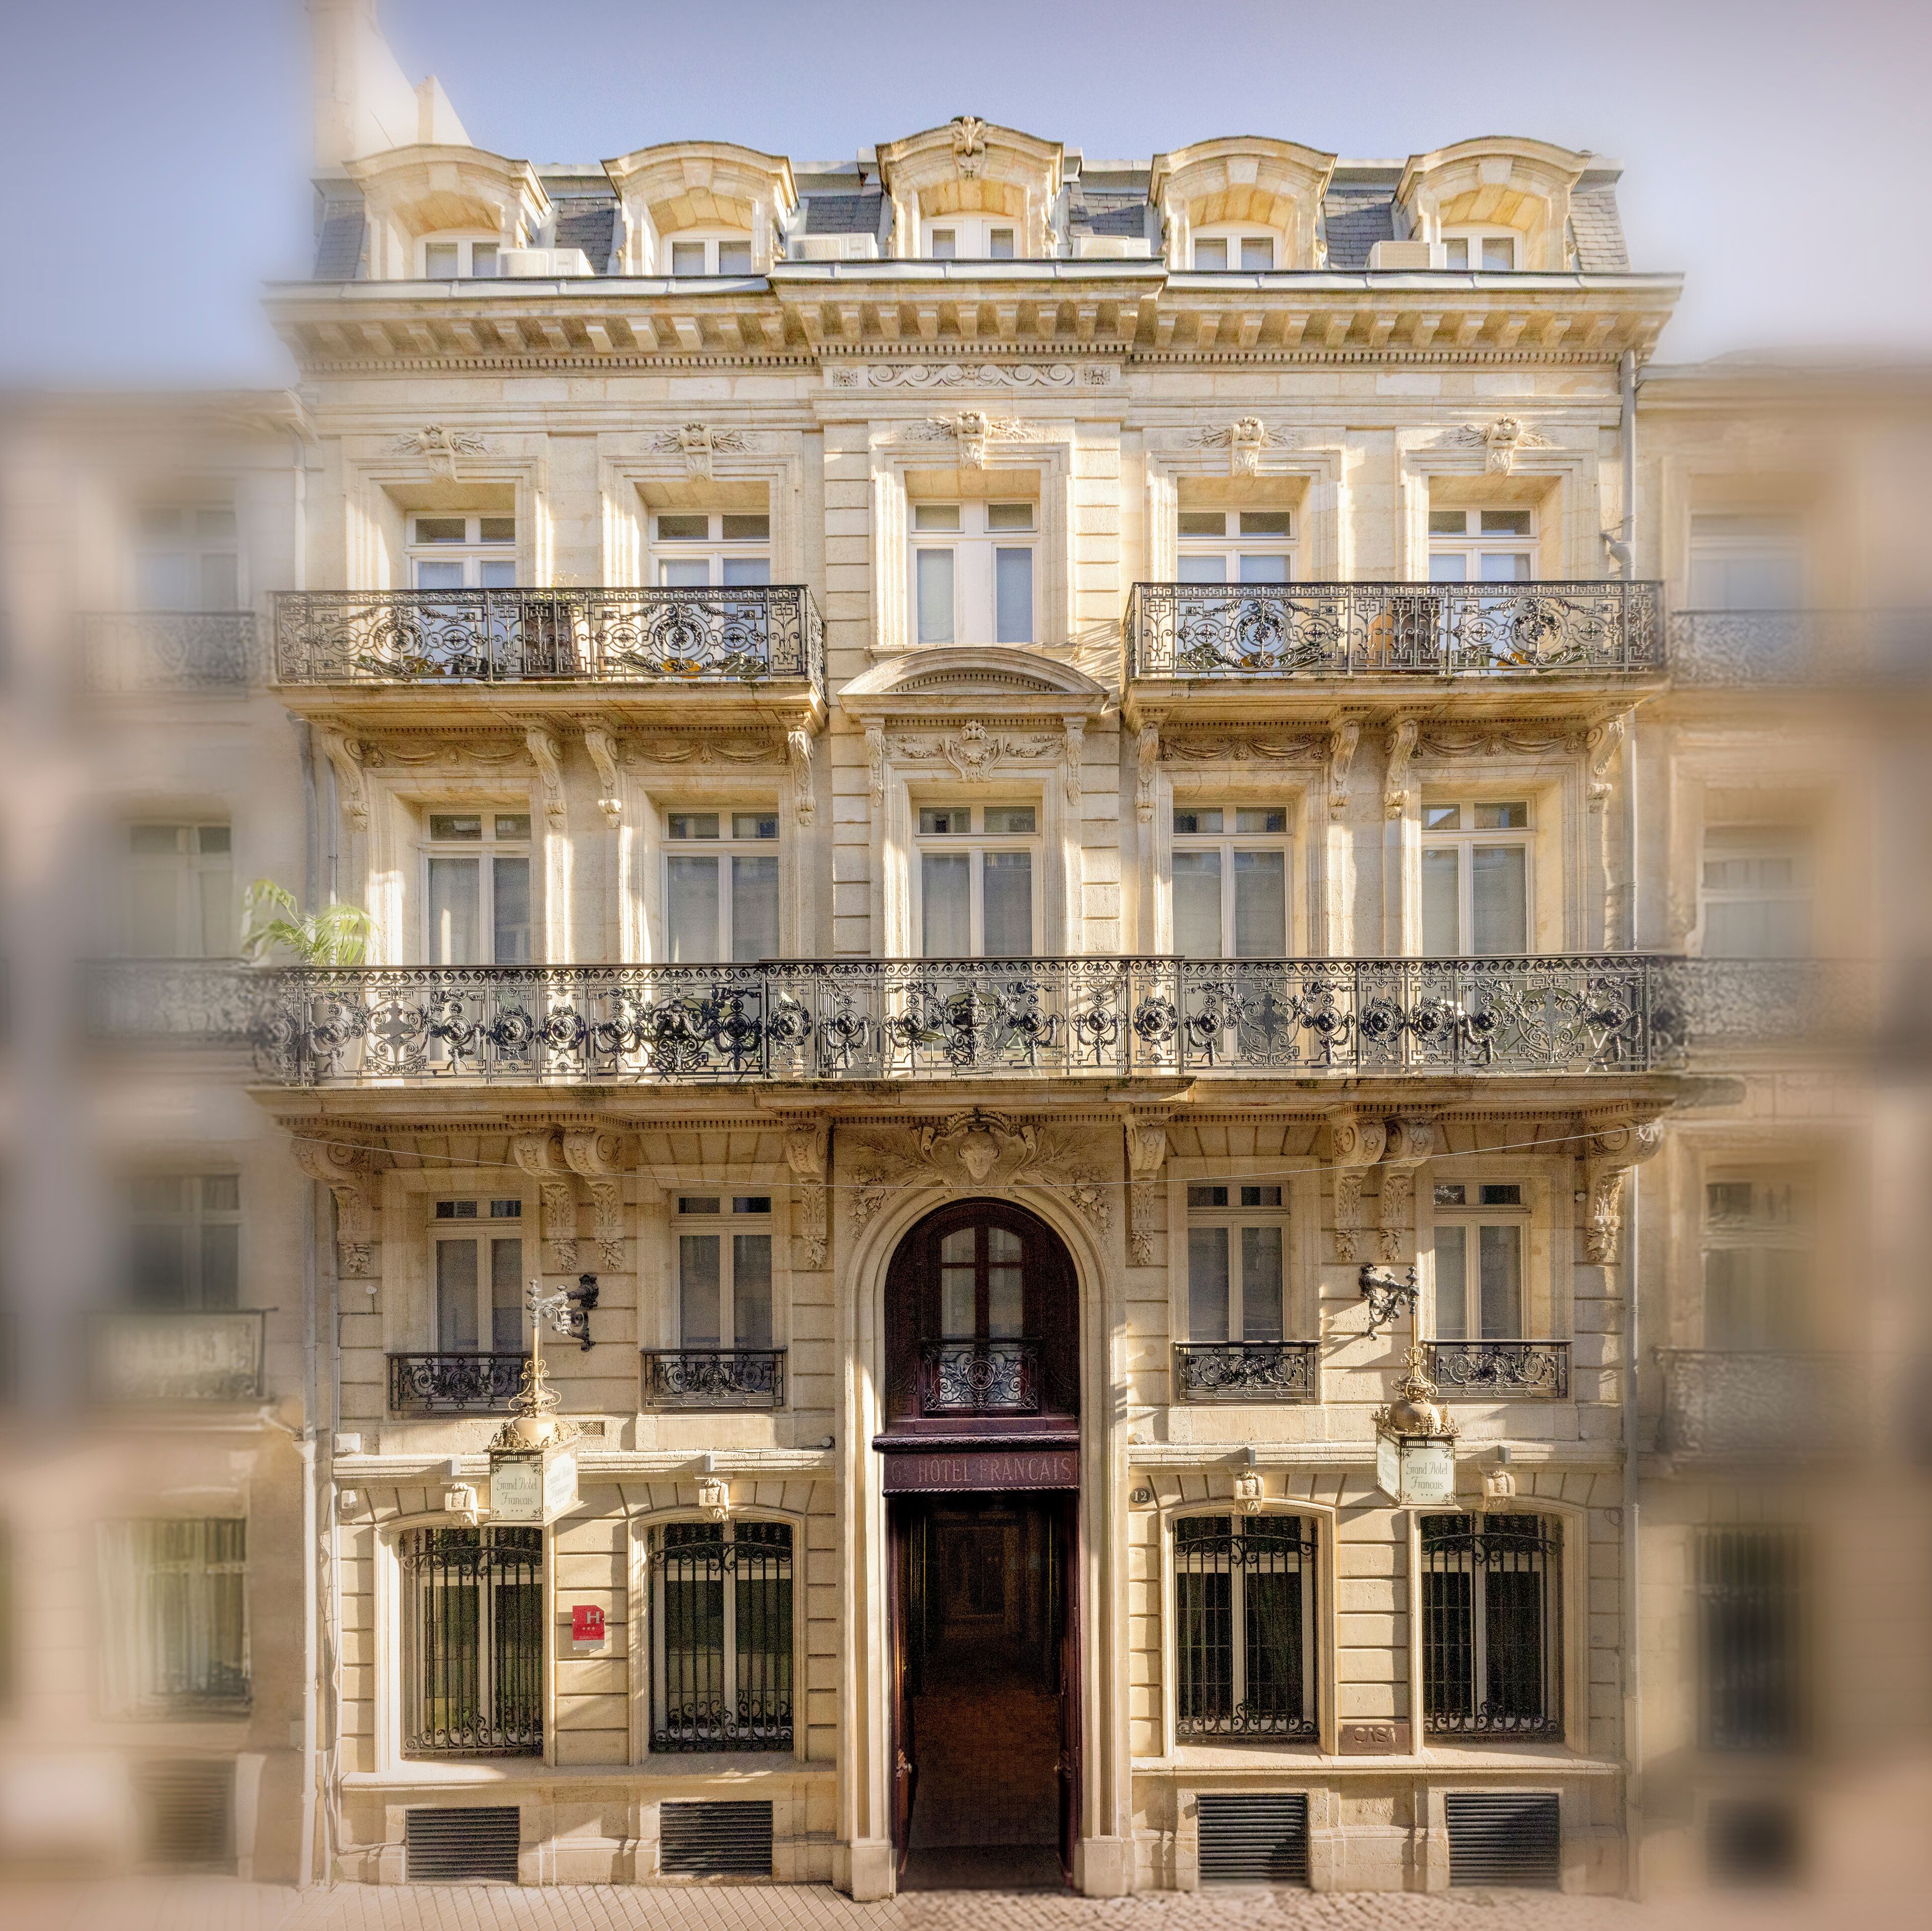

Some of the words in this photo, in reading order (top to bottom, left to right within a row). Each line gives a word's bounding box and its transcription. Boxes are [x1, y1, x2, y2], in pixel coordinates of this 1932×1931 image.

[1406, 1461, 1427, 1475] Grand
[497, 1477, 517, 1491] Grand
[1134, 1490, 1148, 1501] 12
[586, 1611, 601, 1624] H
[1353, 1727, 1398, 1743] CASA
